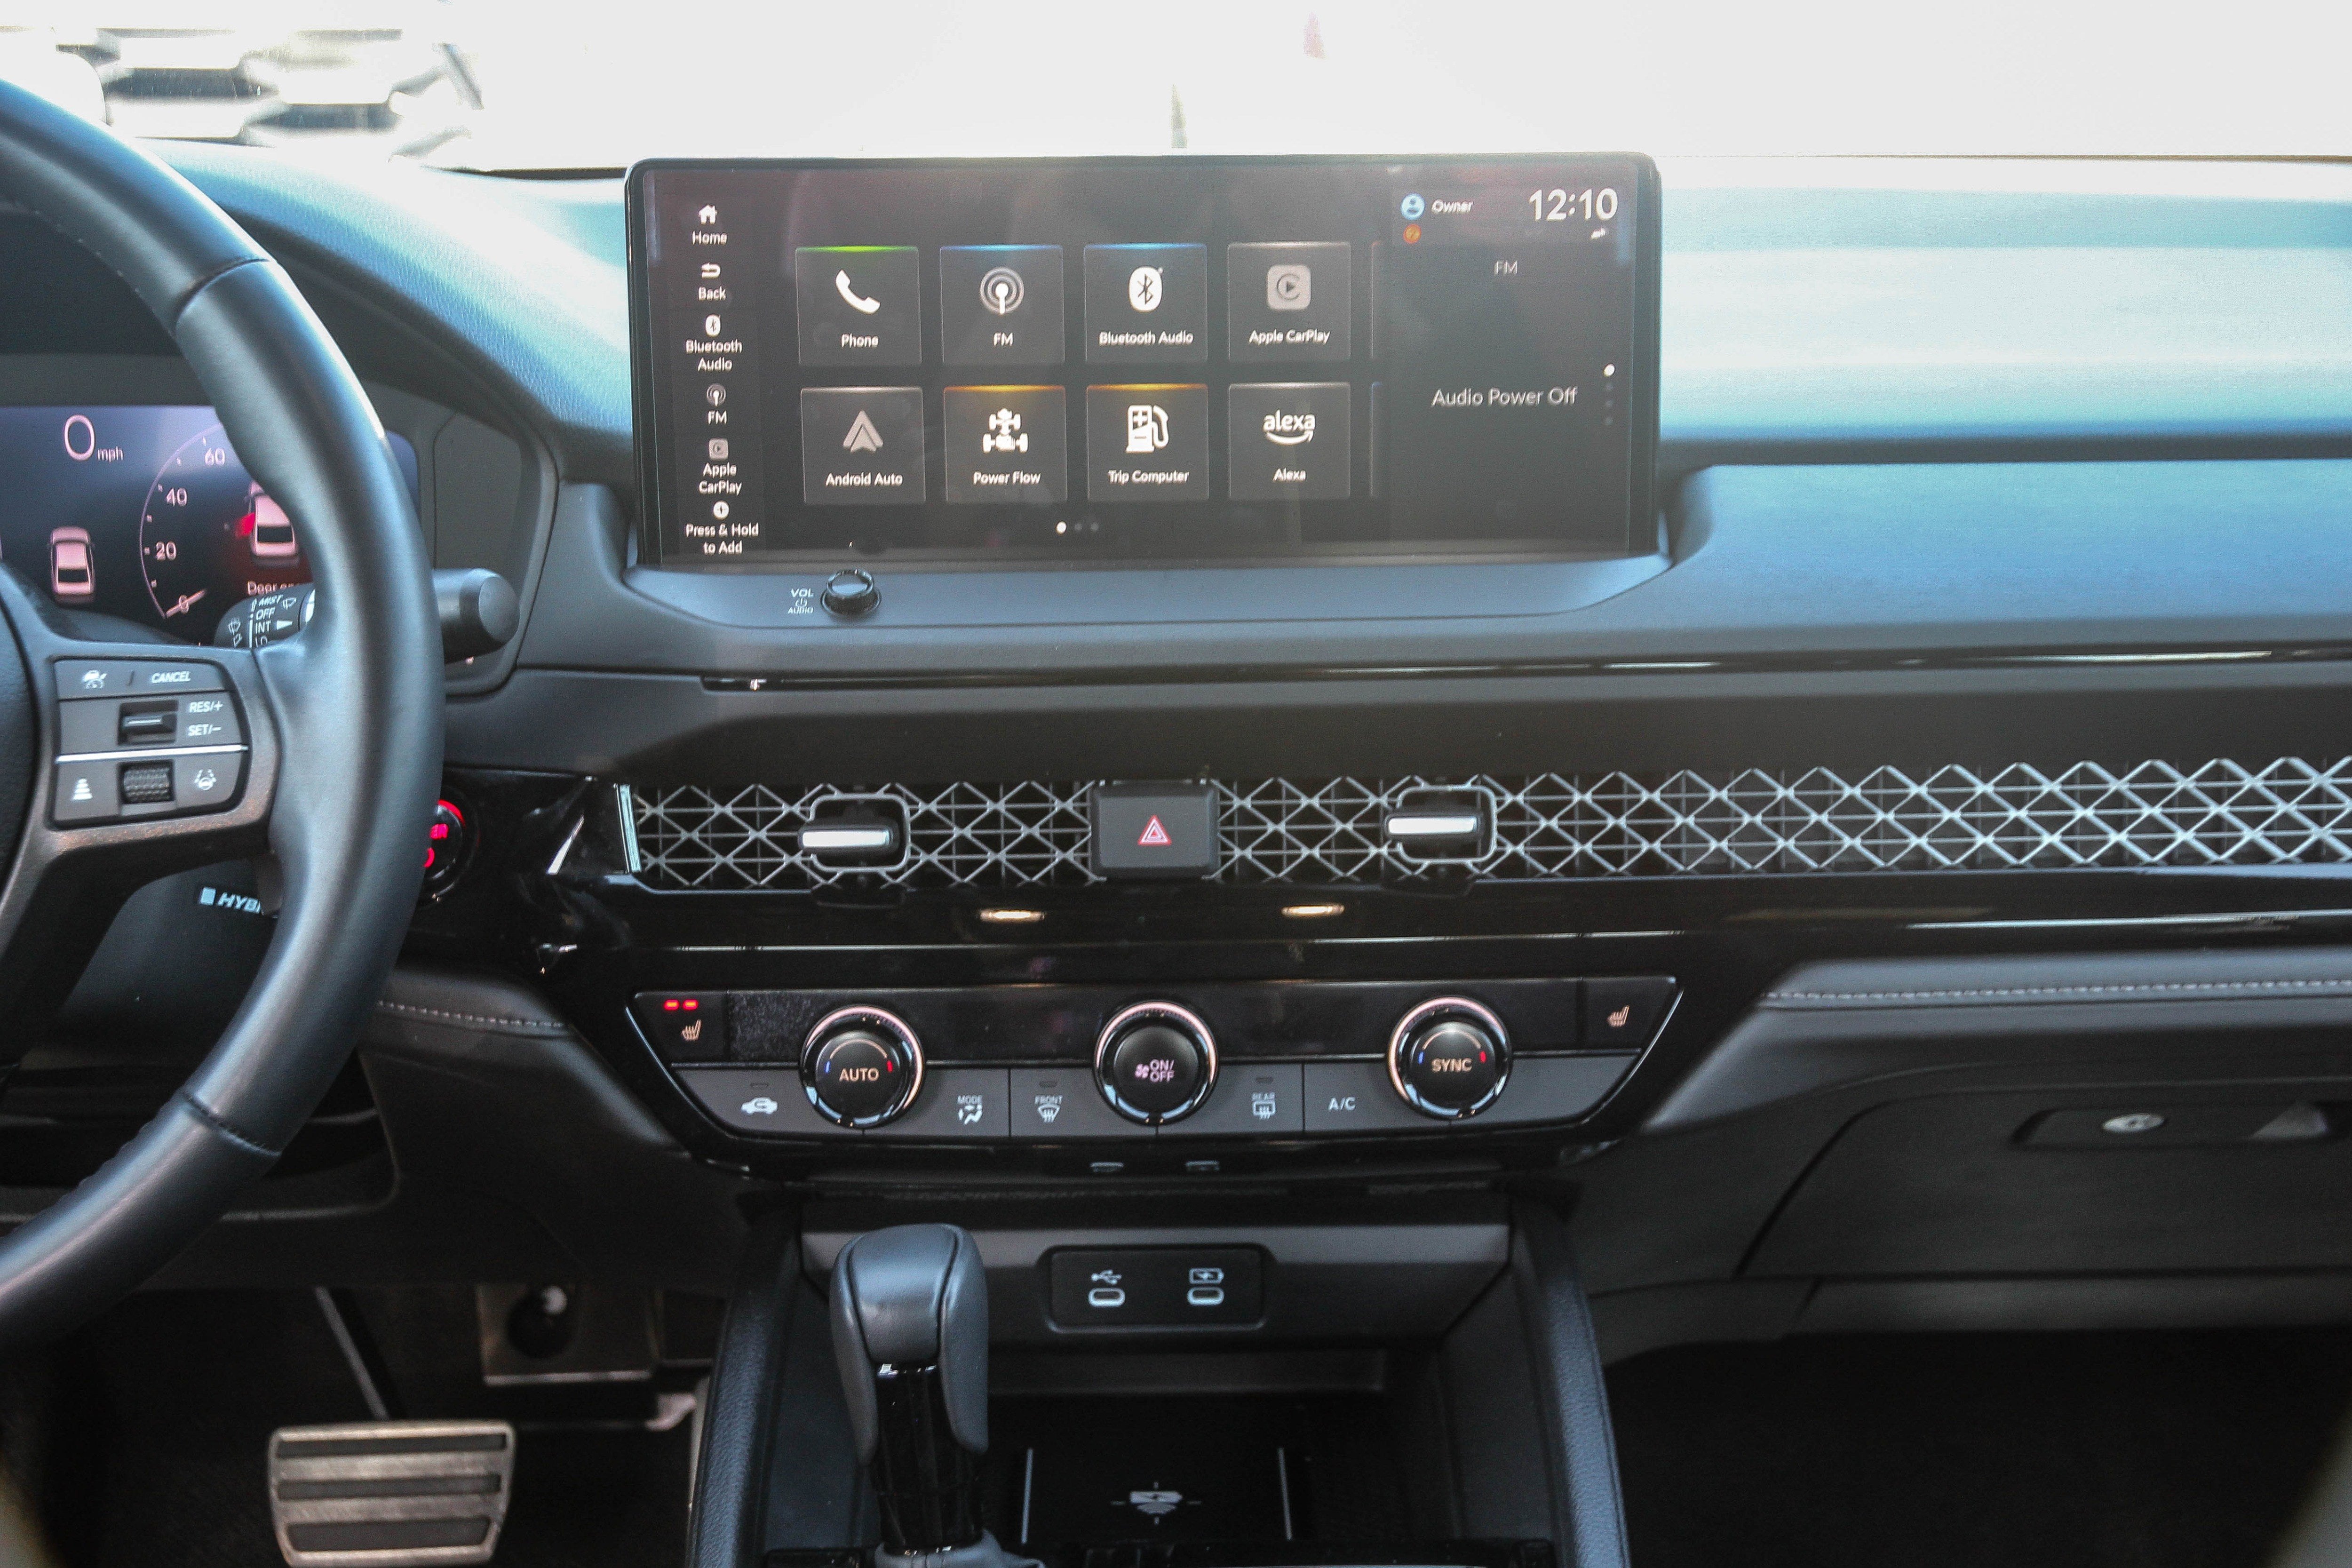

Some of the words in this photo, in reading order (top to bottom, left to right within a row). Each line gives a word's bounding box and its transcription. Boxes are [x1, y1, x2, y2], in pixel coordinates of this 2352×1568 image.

[1431, 199, 1473, 213] Owner
[1529, 188, 1618, 221] 12:10
[692, 231, 727, 245] Home
[1494, 260, 1518, 274] FM
[698, 286, 726, 300] Back
[841, 333, 879, 347] Phone
[993, 333, 1013, 346] FM
[1099, 331, 1156, 345] Bluetooth
[1158, 330, 1193, 344] Audio
[1248, 329, 1284, 345] Apple
[1286, 329, 1330, 344] CarPlay
[685, 339, 742, 353] Bluetooth
[698, 357, 732, 371] Audio
[1431, 388, 1483, 406] Audio
[1488, 388, 1543, 405] Power
[1548, 387, 1577, 404] Off
[707, 411, 727, 424] FM
[1263, 410, 1316, 430] alexa
[64, 415, 95, 460] 0
[97, 446, 123, 462] mph
[204, 447, 225, 466] 60
[703, 462, 737, 478] Apple
[1273, 468, 1306, 481] Alexa
[826, 472, 871, 486] Android
[874, 472, 903, 486] Auto
[973, 471, 1010, 485] Power
[1012, 471, 1041, 484] Flow
[1108, 470, 1129, 485] Trip
[1131, 470, 1189, 485] Computer
[699, 480, 742, 495] CarPlay
[166, 488, 187, 506] 40
[685, 524, 716, 537] Press
[718, 523, 728, 536] &
[731, 523, 759, 536] Hold
[156, 541, 176, 560] 20
[703, 542, 716, 554] to
[718, 541, 742, 554] Add
[247, 581, 278, 596] Door
[791, 588, 814, 597] VOL
[256, 607, 276, 620] OFF
[255, 620, 271, 634] INT
[151, 671, 191, 683] CANCEL
[189, 700, 223, 713] RES/+
[1150, 1059, 1175, 1070] ON/
[1432, 1058, 1472, 1072] SYNC
[839, 1067, 879, 1082] AUTO
[1150, 1070, 1175, 1082] OFF
[957, 1095, 982, 1105] MODE
[1035, 1095, 1063, 1105] FRONT
[1328, 1097, 1355, 1110] A/C
